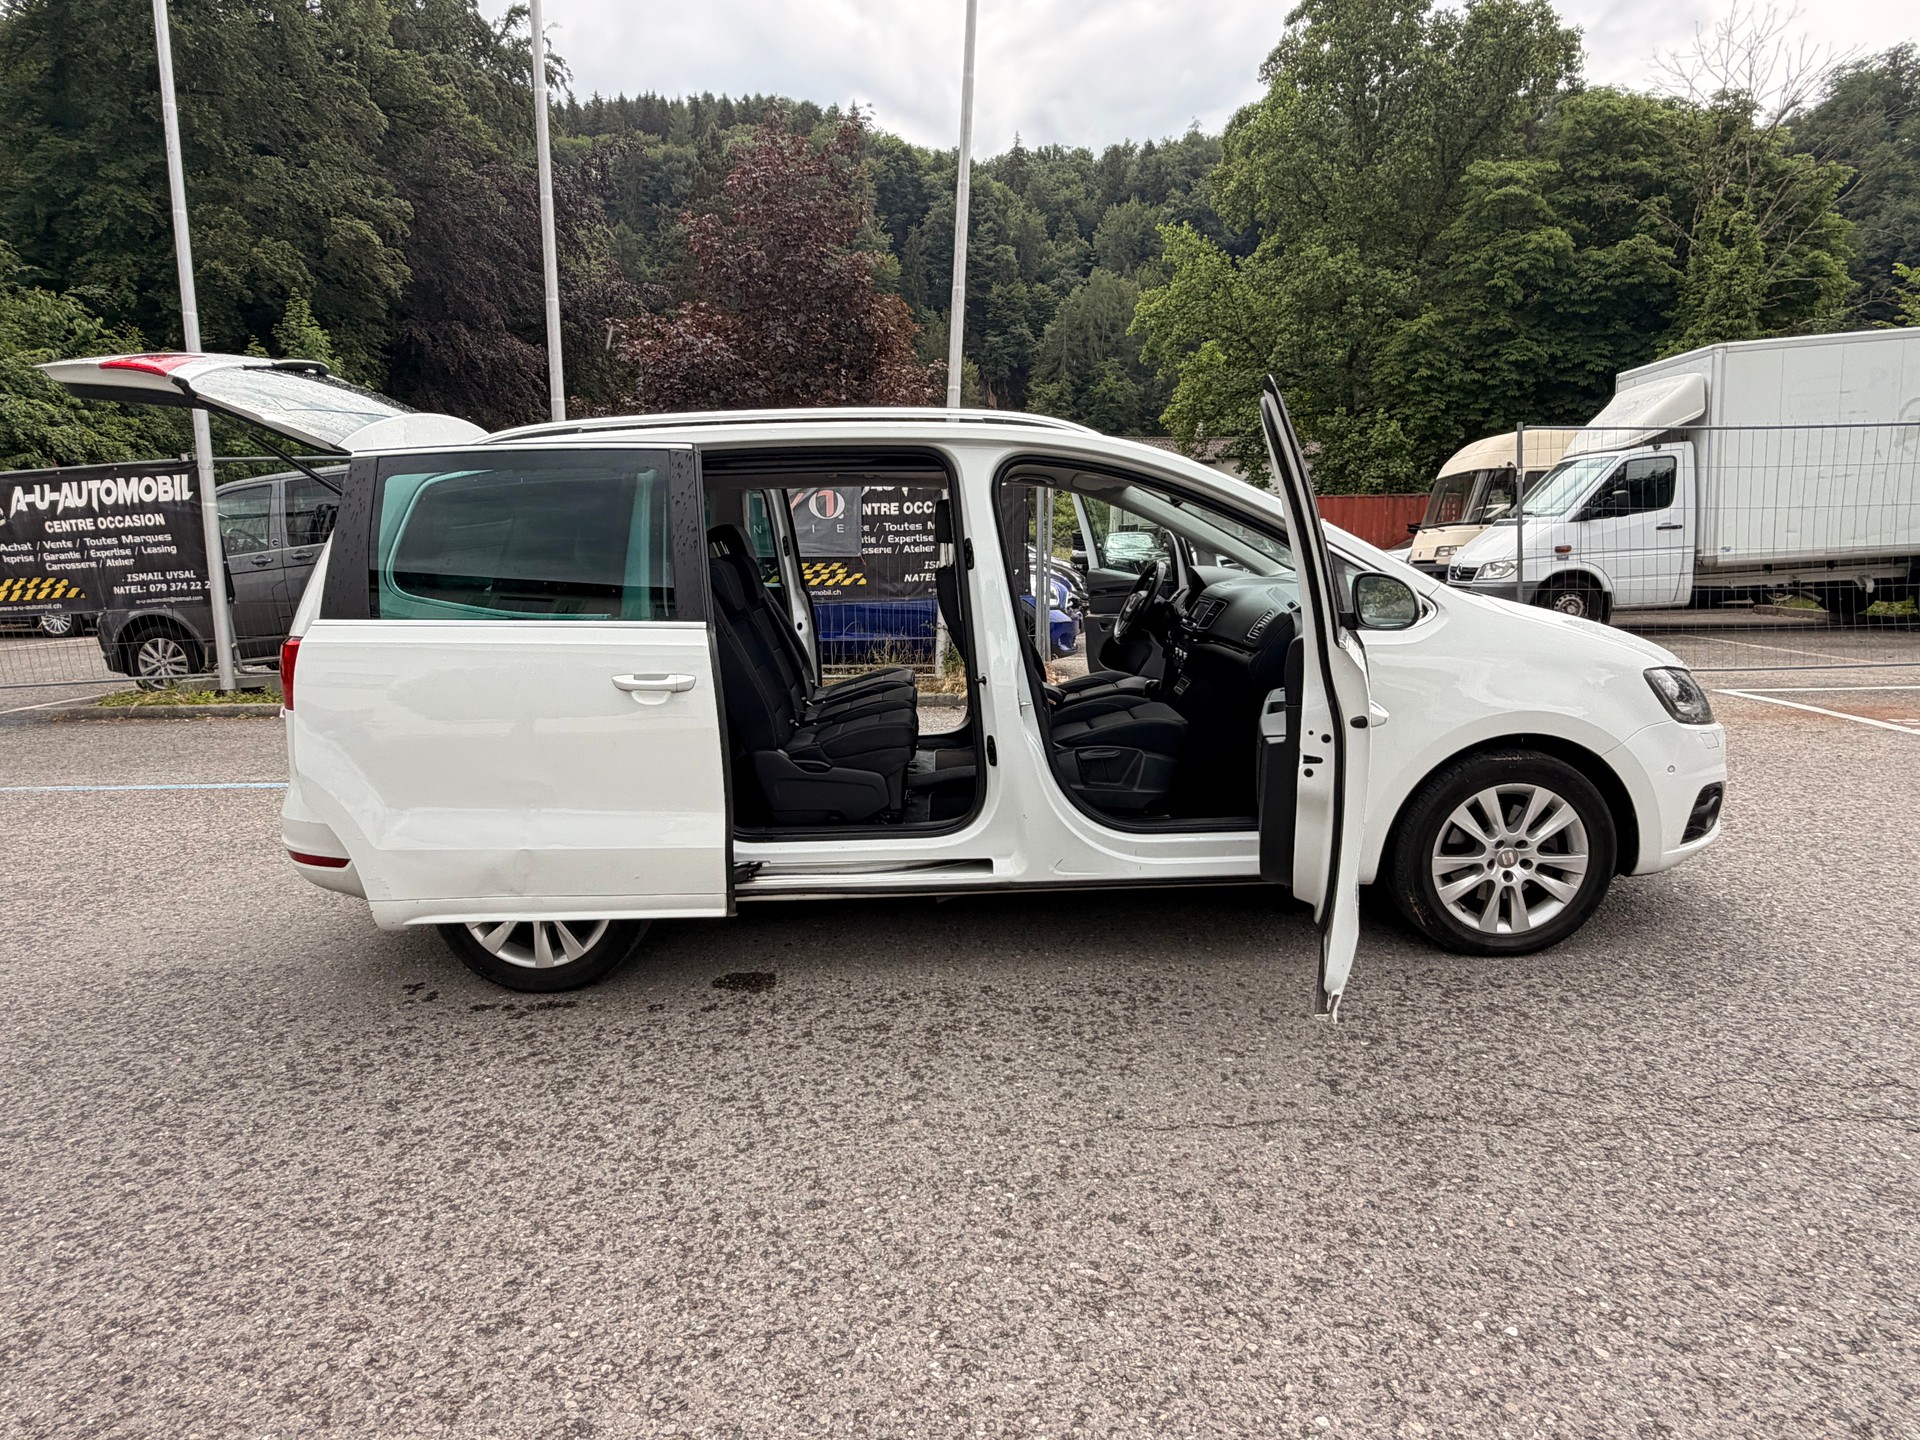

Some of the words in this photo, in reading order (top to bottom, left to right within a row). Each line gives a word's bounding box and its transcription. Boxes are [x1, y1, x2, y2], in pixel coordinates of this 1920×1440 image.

[10, 474, 194, 519] A-U-AUTOMOBIL
[861, 502, 900, 515] NTRE
[902, 500, 936, 514] OCC
[45, 518, 95, 533] CENTRE
[97, 513, 166, 529] OCCASION
[883, 521, 923, 531] Toutes
[0, 542, 33, 552] Achat
[43, 540, 73, 549] Vente
[83, 536, 118, 546] Toutes
[121, 533, 172, 544] Marques
[887, 533, 935, 544] Expertise
[43, 551, 81, 561] Garantie
[90, 547, 132, 558] Expertise
[141, 545, 178, 554] Leasing
[862, 546, 892, 554] sserie
[902, 544, 936, 553] Atelier
[46, 561, 98, 571] Carrosserie
[127, 572, 165, 582] ISMAIL
[166, 570, 197, 580] UYSAL
[903, 573, 937, 582] NATEL
[113, 585, 147, 595] NATEL:
[149, 584, 168, 592] 079
[170, 582, 188, 591] 374
[190, 581, 202, 590] 22
[204, 580, 212, 589] 2
